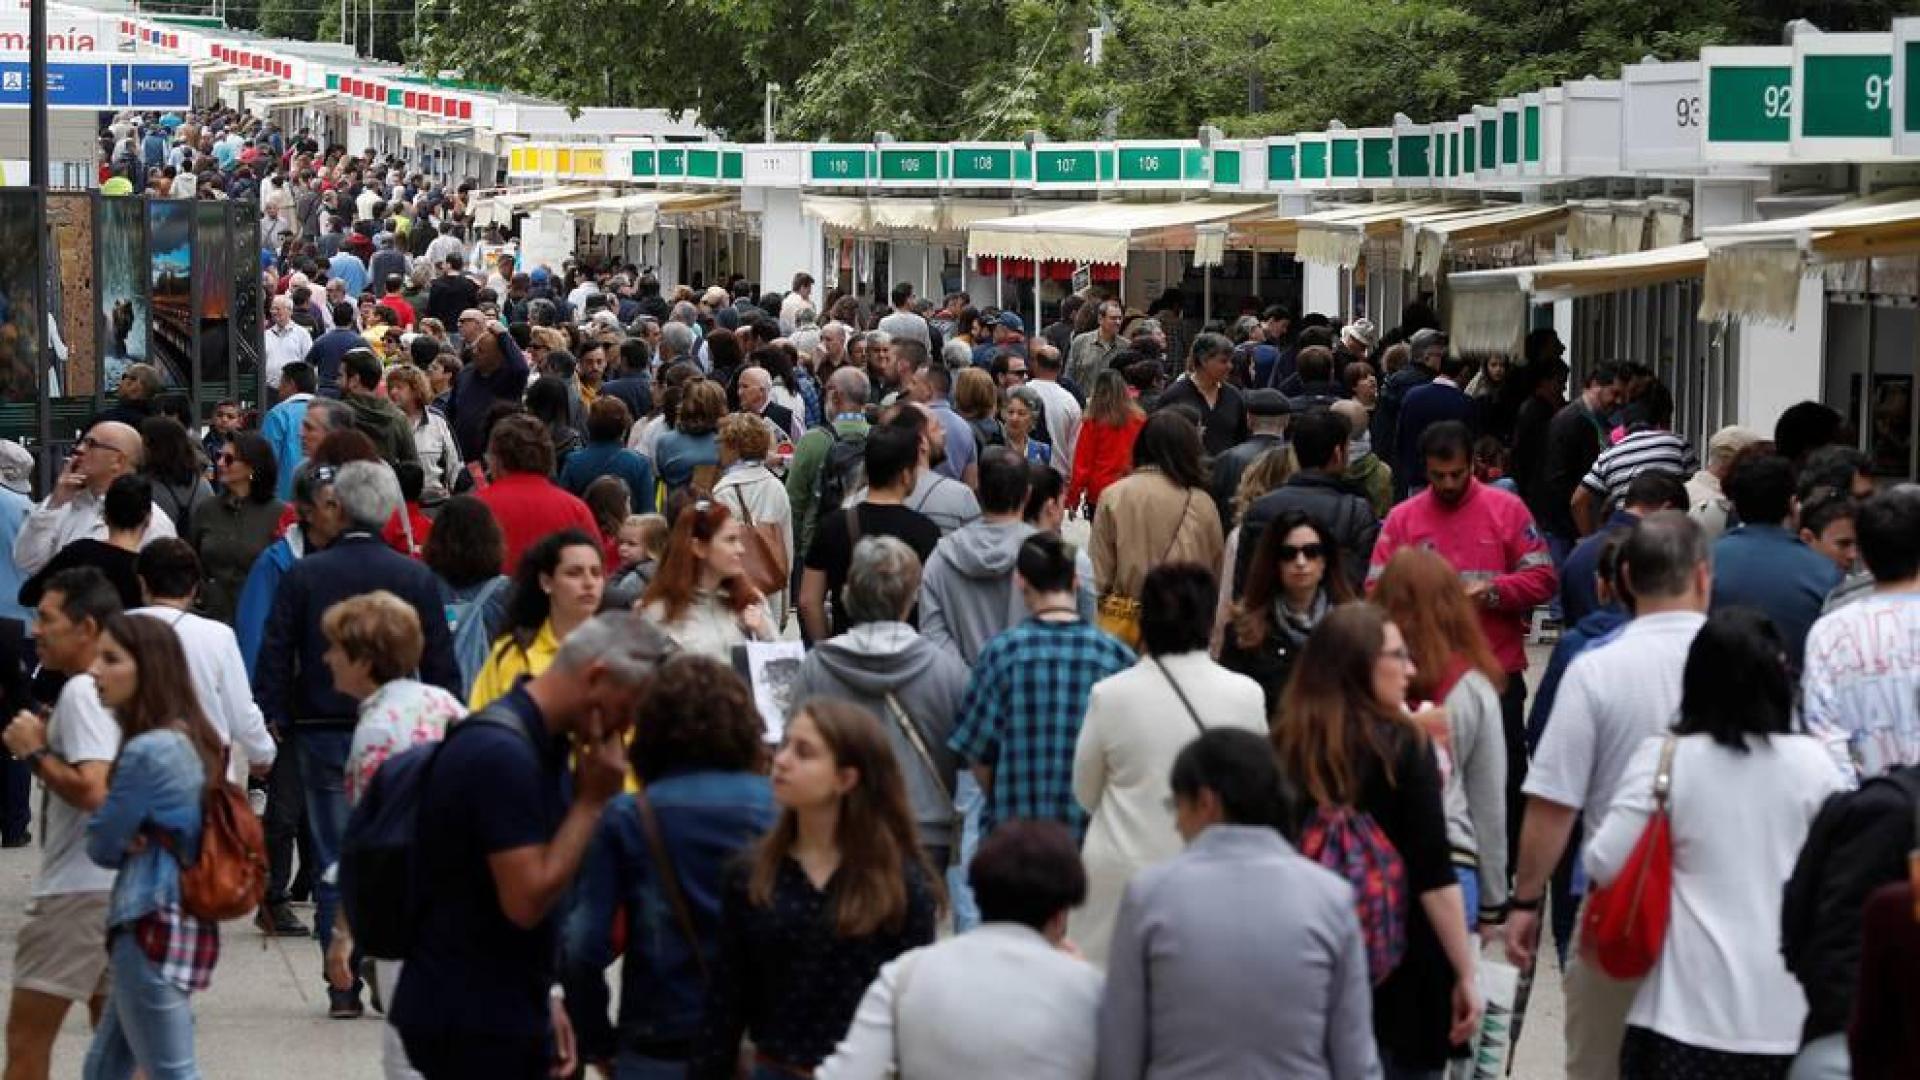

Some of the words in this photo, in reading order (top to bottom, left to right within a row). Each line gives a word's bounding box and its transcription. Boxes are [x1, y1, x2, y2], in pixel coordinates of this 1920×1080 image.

[0, 27, 94, 51] mnía
[137, 79, 174, 92] MADRID
[1764, 85, 1792, 118] 92
[1676, 97, 1700, 127] 93
[829, 159, 849, 174] 110
[901, 158, 920, 172] 109
[974, 156, 993, 170] 108
[1056, 158, 1077, 172] 107
[1138, 156, 1159, 171] 106
